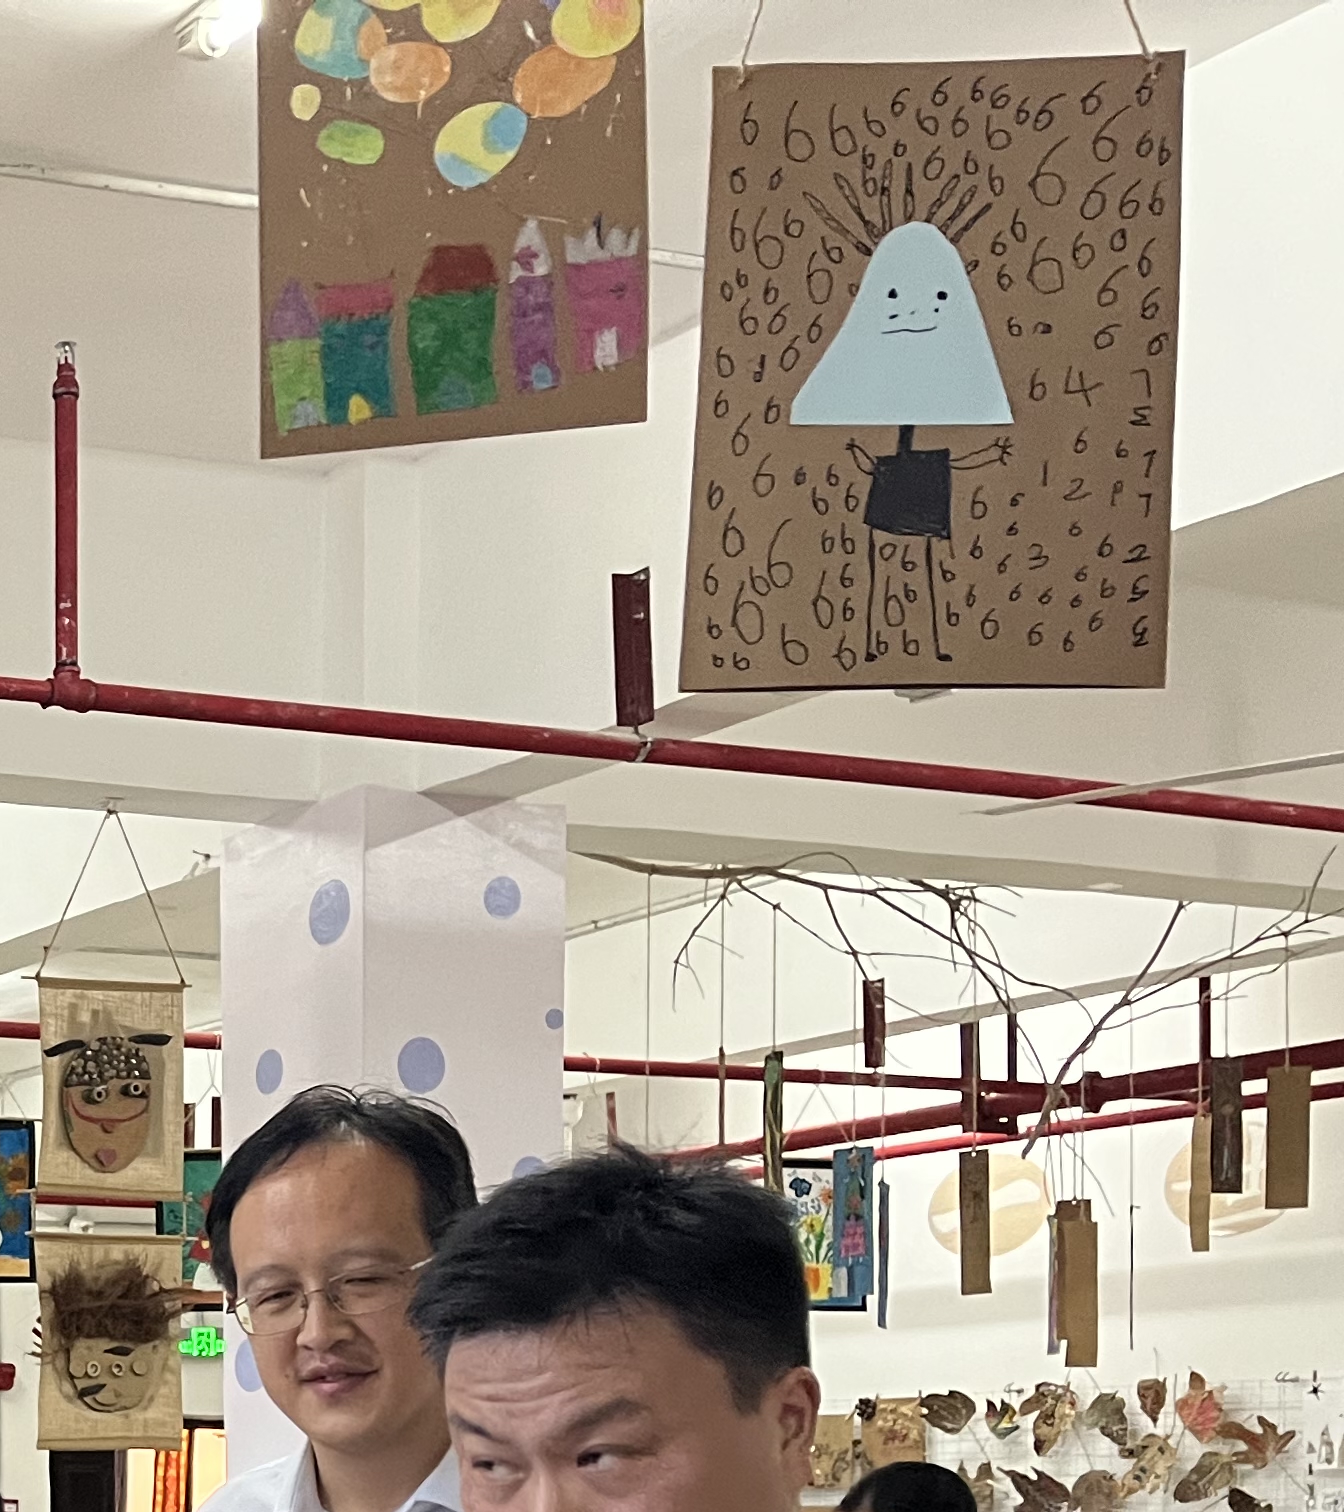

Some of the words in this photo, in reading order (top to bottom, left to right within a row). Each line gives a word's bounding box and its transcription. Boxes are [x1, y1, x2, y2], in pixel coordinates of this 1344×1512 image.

[890, 88, 910, 118] 6
[931, 76, 952, 107] 6
[971, 76, 986, 103] 6
[990, 84, 1011, 109] 6
[1080, 81, 1106, 115] 6
[740, 101, 759, 146] 6
[862, 106, 886, 138] 6
[915, 108, 939, 136] 6
[951, 106, 969, 138] 6
[1013, 96, 1030, 127] 6
[1032, 93, 1066, 132] 6
[784, 100, 815, 163] 6
[828, 103, 858, 157] 6
[985, 115, 1012, 150] 6
[1092, 105, 1131, 162] 6
[1136, 130, 1153, 158] 6
[923, 145, 945, 181] 6
[963, 150, 979, 175] 6
[1028, 136, 1069, 206] 6
[729, 167, 746, 194] 6
[988, 164, 1004, 197] 6
[1080, 172, 1116, 220] 6
[1119, 179, 1142, 219] 6
[1148, 181, 1165, 216] 6
[730, 208, 746, 253] 6
[752, 207, 784, 270] 6
[783, 209, 804, 238] 6
[1010, 208, 1027, 243] 6
[821, 236, 844, 264] 6
[990, 230, 1007, 256] 6
[1072, 231, 1095, 270] 6
[1137, 238, 1156, 278] 6
[736, 268, 748, 289] 6
[806, 250, 833, 304] 6
[997, 264, 1014, 292] 6
[1026, 236, 1064, 295] 6
[763, 277, 779, 305] 6
[1097, 265, 1129, 307] 6
[739, 297, 759, 336] 6
[1140, 287, 1161, 320] 6
[767, 303, 791, 335] 6
[807, 313, 823, 344] 6
[1007, 317, 1022, 337] 6
[1094, 324, 1122, 350] 6
[716, 346, 735, 378] 6
[778, 335, 800, 372] 6
[1029, 368, 1046, 401] 6
[1064, 366, 1104, 407] 4
[1130, 369, 1152, 398] 7
[713, 390, 729, 418] 6
[764, 395, 781, 424] 6
[731, 412, 751, 456] 6
[1073, 427, 1088, 454] 6
[1115, 439, 1129, 458] 6
[752, 453, 775, 497] 6
[826, 464, 840, 487] 6
[1042, 460, 1048, 486] 1
[707, 480, 724, 511] 6
[811, 486, 829, 516] 6
[844, 482, 859, 513] 6
[970, 485, 988, 520] 6
[1063, 478, 1092, 501] 2
[722, 507, 745, 558] 6
[821, 529, 835, 554] 6
[841, 522, 855, 555] 6
[1068, 520, 1082, 537] 6
[767, 518, 793, 588] 6
[900, 545, 918, 572] 6
[969, 534, 983, 559] 6
[1029, 543, 1049, 570] 3
[1097, 534, 1113, 558] 6
[1122, 544, 1151, 563] 2
[703, 563, 718, 596] 6
[840, 563, 854, 588] 6
[939, 560, 956, 583] 6
[997, 554, 1012, 575] 6
[1074, 566, 1088, 582] 6
[749, 566, 771, 596] 6
[903, 582, 917, 603] 6
[965, 584, 976, 608] 6
[1009, 582, 1022, 601] 6
[1100, 578, 1117, 598] 6
[811, 570, 835, 629] 6
[842, 597, 855, 622] 6
[884, 576, 905, 627] 6
[1037, 587, 1053, 606] 6
[1069, 594, 1082, 608] 6
[707, 616, 723, 639] 6
[731, 580, 764, 645] 6
[946, 601, 960, 627] 6
[980, 608, 999, 640] 6
[1088, 610, 1104, 632] 6
[781, 623, 809, 665] 6
[902, 629, 919, 656] 6
[1027, 622, 1043, 646] 6
[1063, 630, 1074, 652] 6
[733, 652, 750, 671] 6
[832, 630, 856, 672] 6
